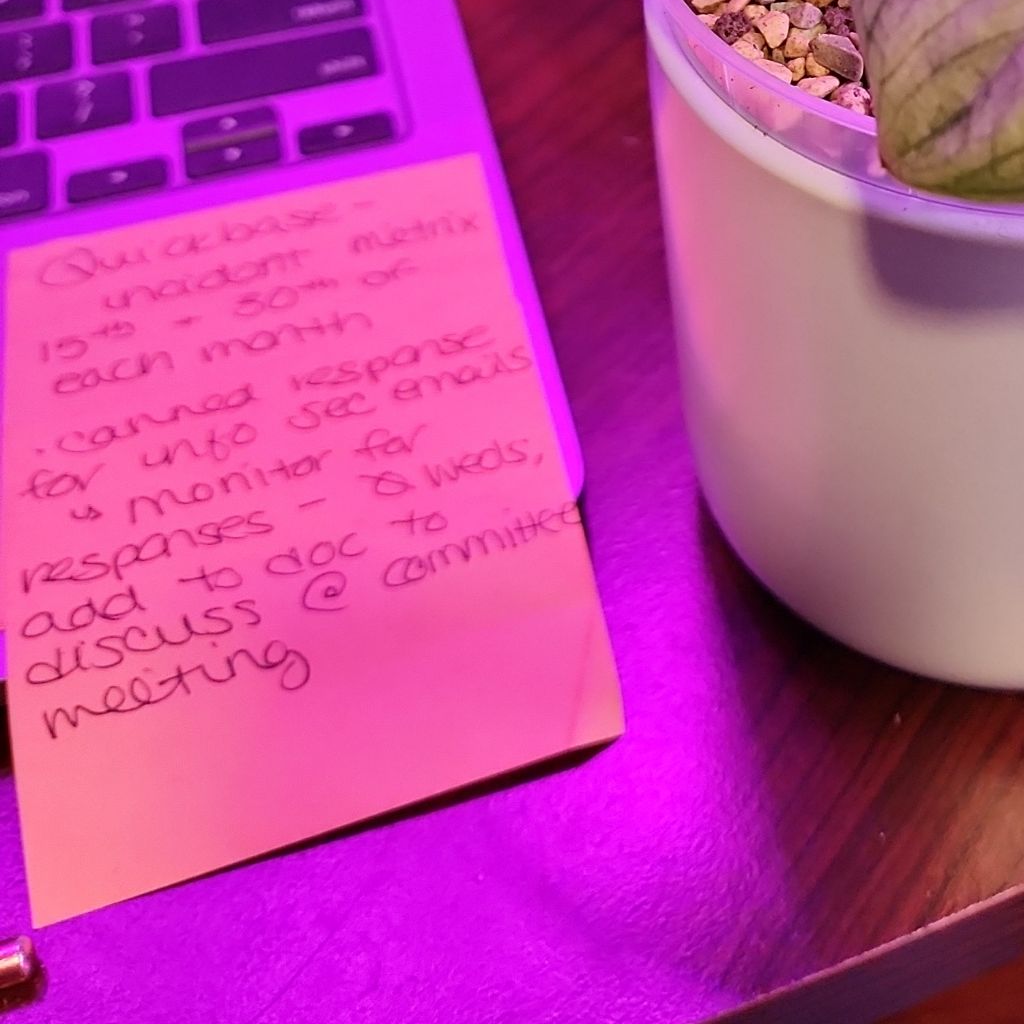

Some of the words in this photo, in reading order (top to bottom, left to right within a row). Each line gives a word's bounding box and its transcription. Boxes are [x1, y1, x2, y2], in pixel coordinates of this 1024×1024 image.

[52, 350, 174, 395] each
[200, 311, 373, 363] month
[57, 383, 260, 454] canned
[289, 324, 497, 392] response
[18, 463, 105, 500] for
[393, 345, 533, 402] emails
[128, 448, 333, 525] monitor
[354, 424, 428, 462] for
[21, 584, 146, 638] add
[178, 564, 243, 592] to
[265, 531, 368, 577] doc
[390, 510, 448, 535] to
[22, 510, 275, 594] responses
[25, 598, 262, 685] discuss
[303, 570, 348, 612] @
[383, 500, 584, 588] committee
[43, 639, 312, 740] meeting
